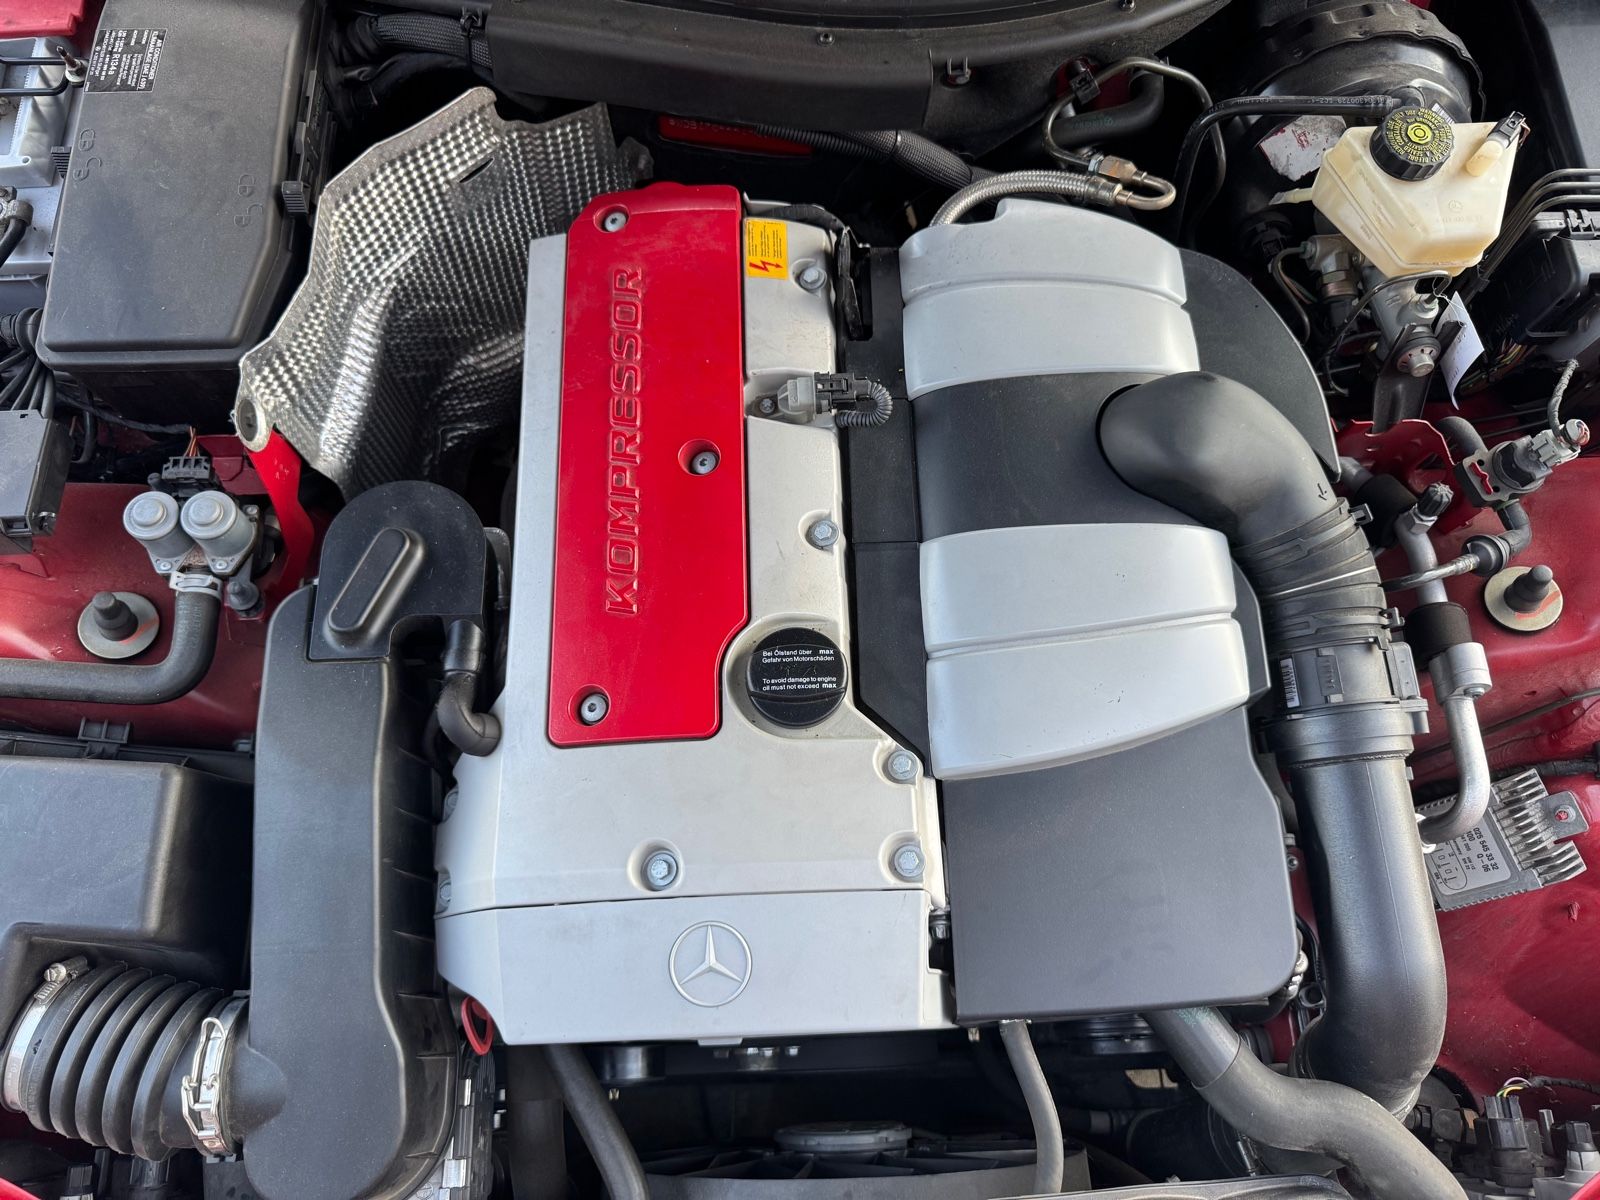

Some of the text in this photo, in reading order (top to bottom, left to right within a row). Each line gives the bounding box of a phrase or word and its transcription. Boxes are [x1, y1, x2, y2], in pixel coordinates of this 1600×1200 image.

[108, 54, 120, 75] R134a
[606, 266, 642, 614] KOMPRESSOR
[1480, 840, 1490, 852] 545
[1486, 853, 1494, 861] 33
[1490, 862, 1499, 870] 32
